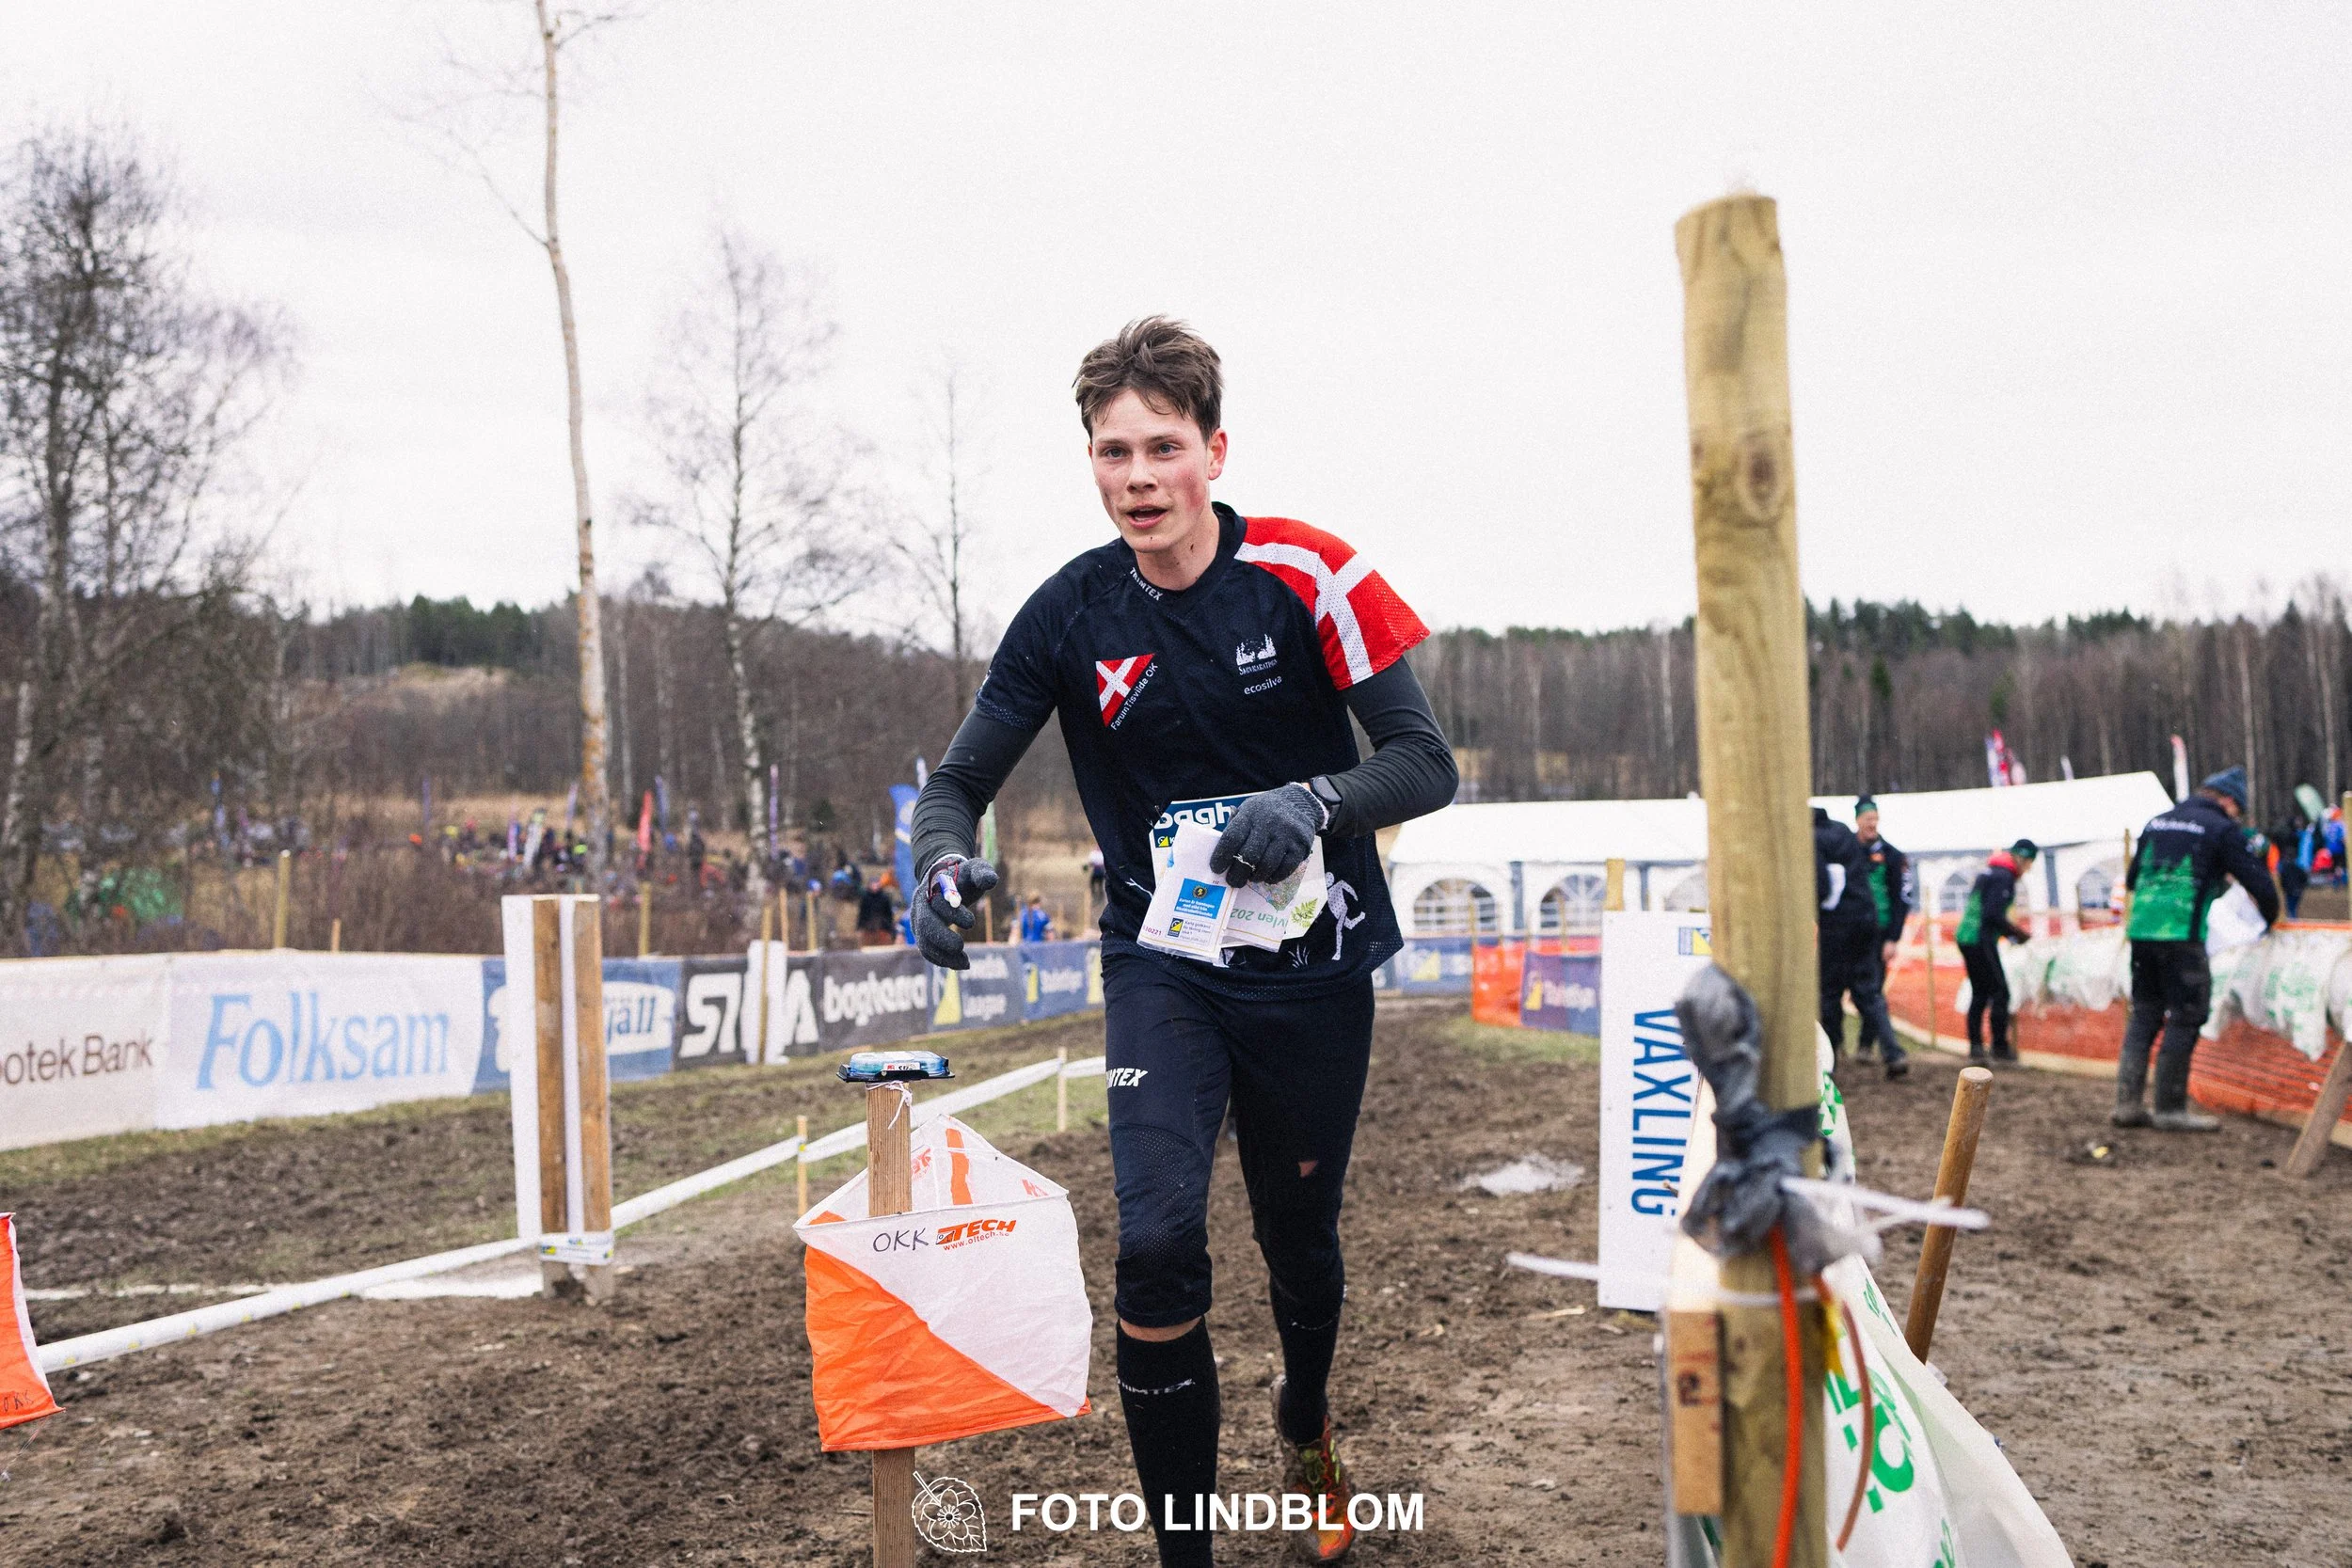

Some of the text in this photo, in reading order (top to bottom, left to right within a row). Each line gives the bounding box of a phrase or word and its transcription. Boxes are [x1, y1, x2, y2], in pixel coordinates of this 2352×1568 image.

[1130, 567, 1163, 600] TRIMTEX
[1244, 675, 1282, 694] ecosilva
[196, 990, 449, 1090] Folksam
[0, 1035, 153, 1085] otek Bank
[872, 1227, 929, 1252] OKK
